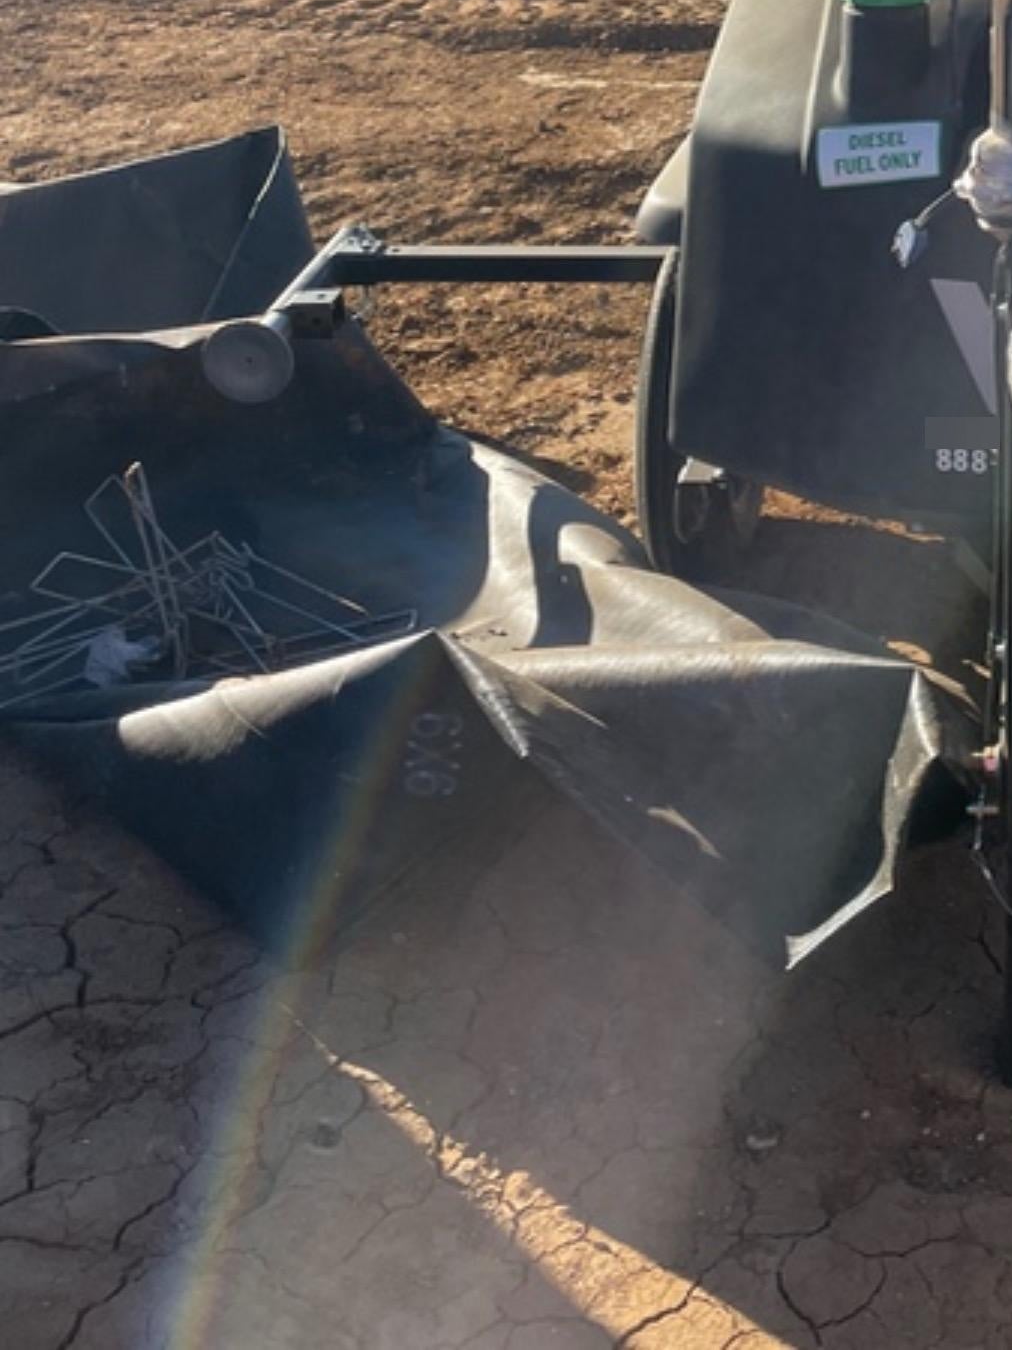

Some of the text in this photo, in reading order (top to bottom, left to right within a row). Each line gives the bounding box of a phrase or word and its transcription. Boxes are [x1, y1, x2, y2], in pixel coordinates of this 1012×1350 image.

[848, 131, 908, 150] DIESEL
[834, 150, 922, 176] FUEL ONLY
